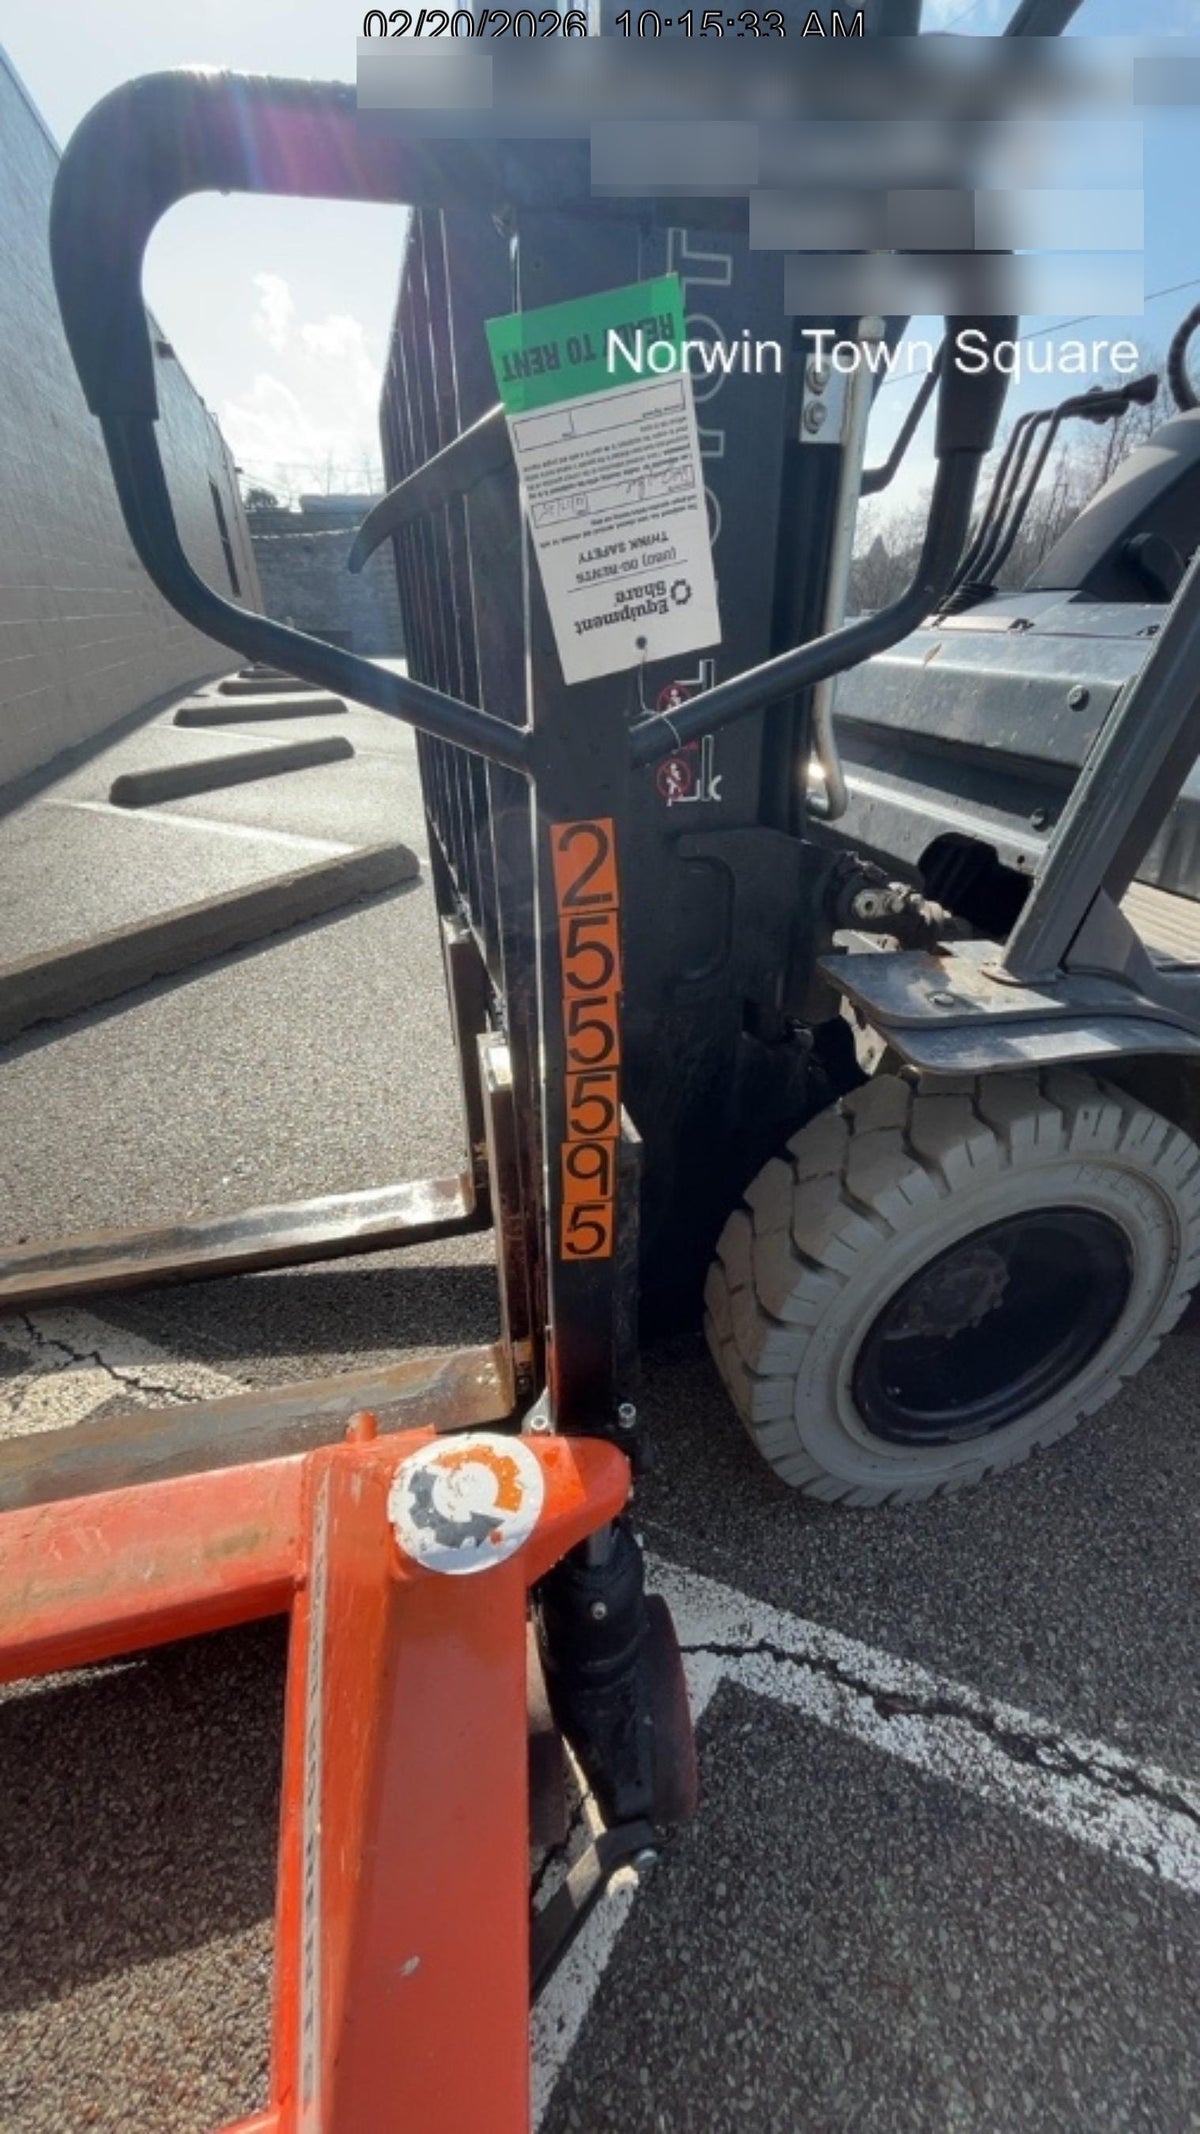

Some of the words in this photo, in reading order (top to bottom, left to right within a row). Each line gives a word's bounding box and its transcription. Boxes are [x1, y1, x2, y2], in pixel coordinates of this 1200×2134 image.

[502, 342, 560, 382] RENT
[566, 333, 596, 365] TO
[578, 542, 626, 564] SAFETY
[628, 531, 669, 548] THINK
[615, 580, 667, 604] Share
[573, 598, 669, 635] Equipment
[558, 825, 614, 1255] 255595
